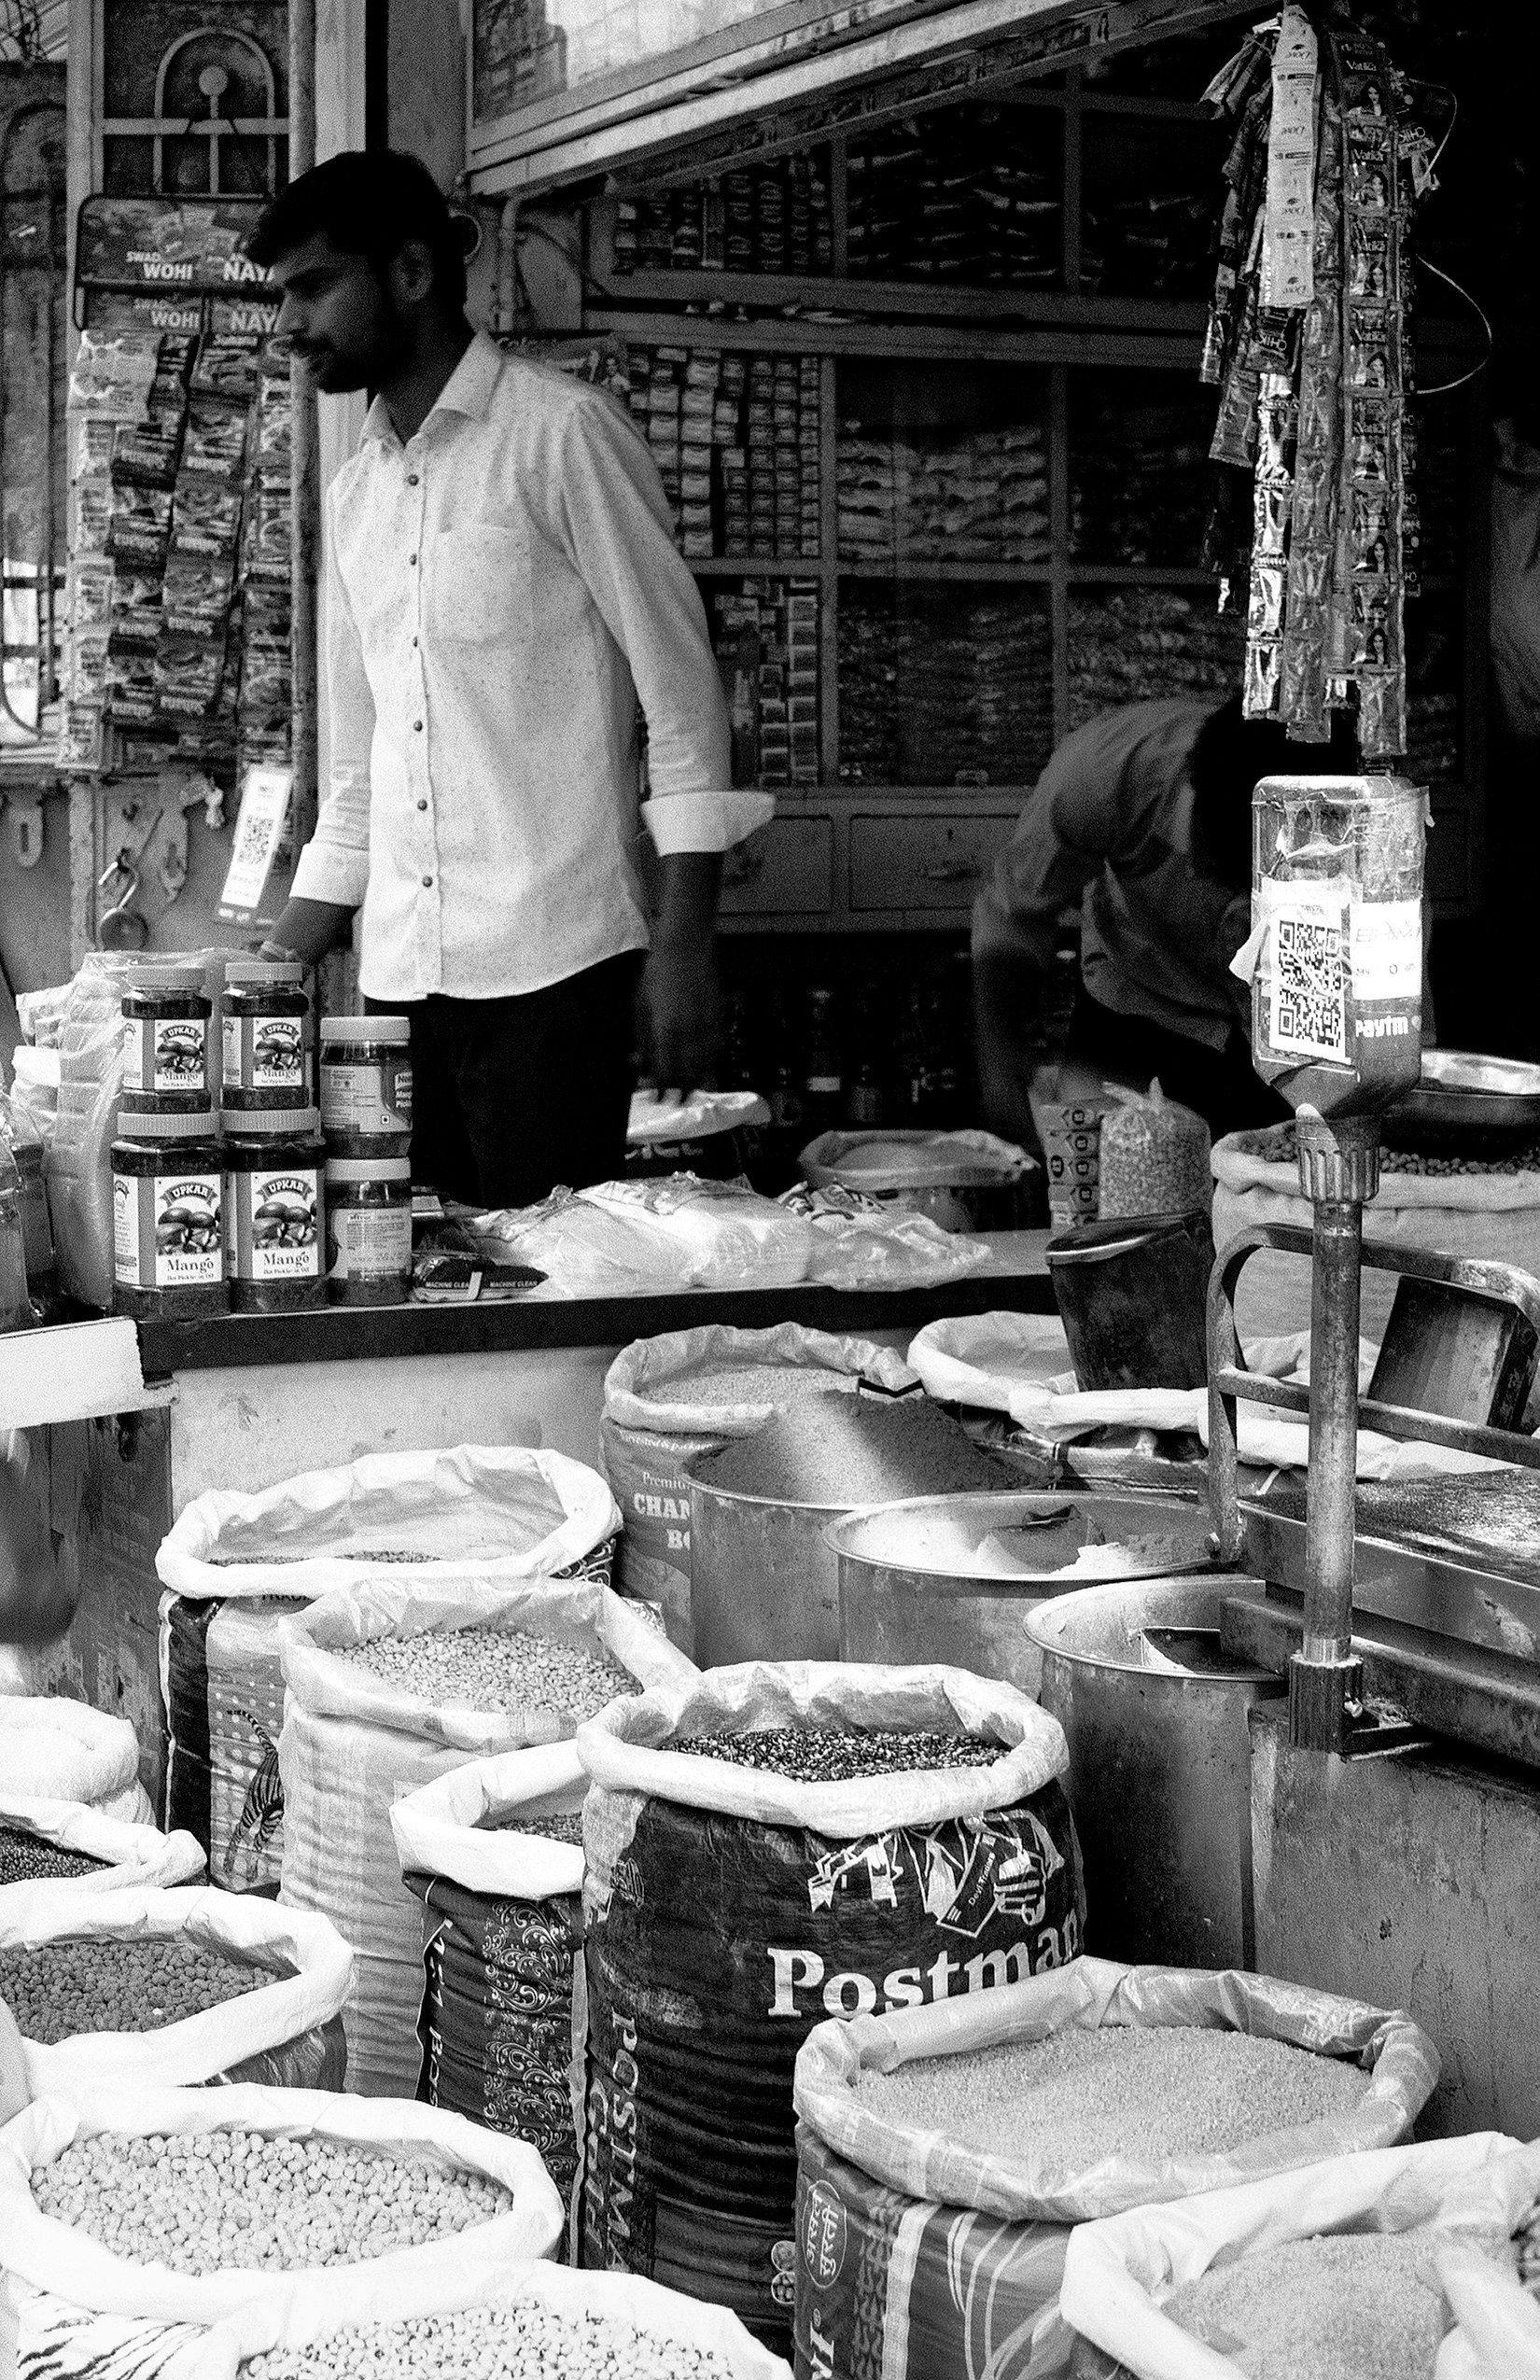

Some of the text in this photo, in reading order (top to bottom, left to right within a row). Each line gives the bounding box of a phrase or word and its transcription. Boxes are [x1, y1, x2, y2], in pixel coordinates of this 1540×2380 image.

[143, 262, 193, 280] WOHI
[150, 311, 201, 328] WOHI
[167, 1026, 196, 1038] UPKAR
[266, 1024, 294, 1036] UPKAR
[162, 1071, 199, 1083] Mango
[262, 1068, 297, 1080] Mango
[172, 1183, 208, 1198] UPKAR
[268, 1178, 304, 1193] UPKAR
[167, 1257, 215, 1274] Mango
[263, 1252, 310, 1267] Mango
[642, 1471, 692, 1490] Premiu
[767, 1907, 1081, 2020] Postman
[607, 2006, 639, 2274] POSTMA
[819, 2205, 840, 2277] सुरती
